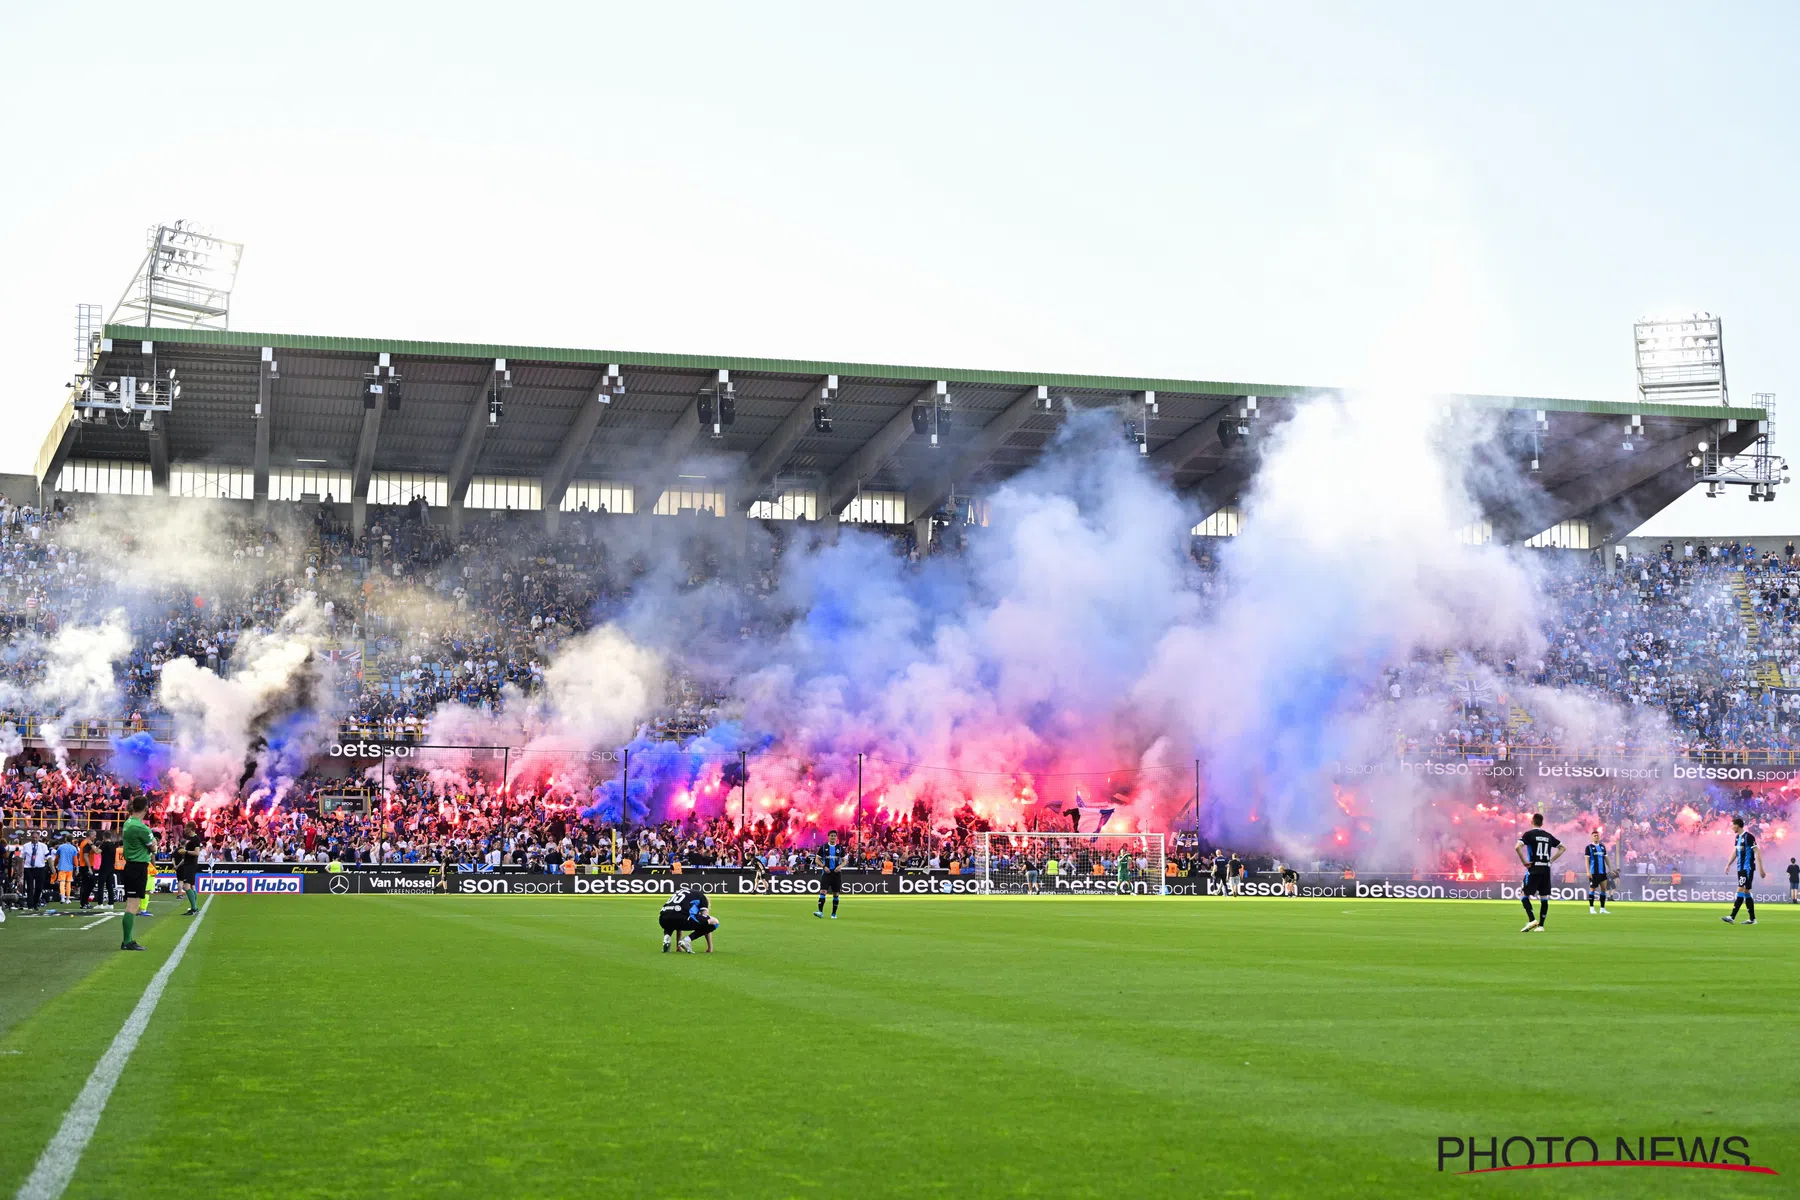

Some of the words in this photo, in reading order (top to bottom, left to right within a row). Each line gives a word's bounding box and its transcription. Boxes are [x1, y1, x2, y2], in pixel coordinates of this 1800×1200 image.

[1536, 842, 1550, 860] 44
[201, 879, 246, 891] Hubo
[254, 879, 298, 891] Hubo
[369, 878, 394, 888] Van
[395, 877, 435, 888] Mossel
